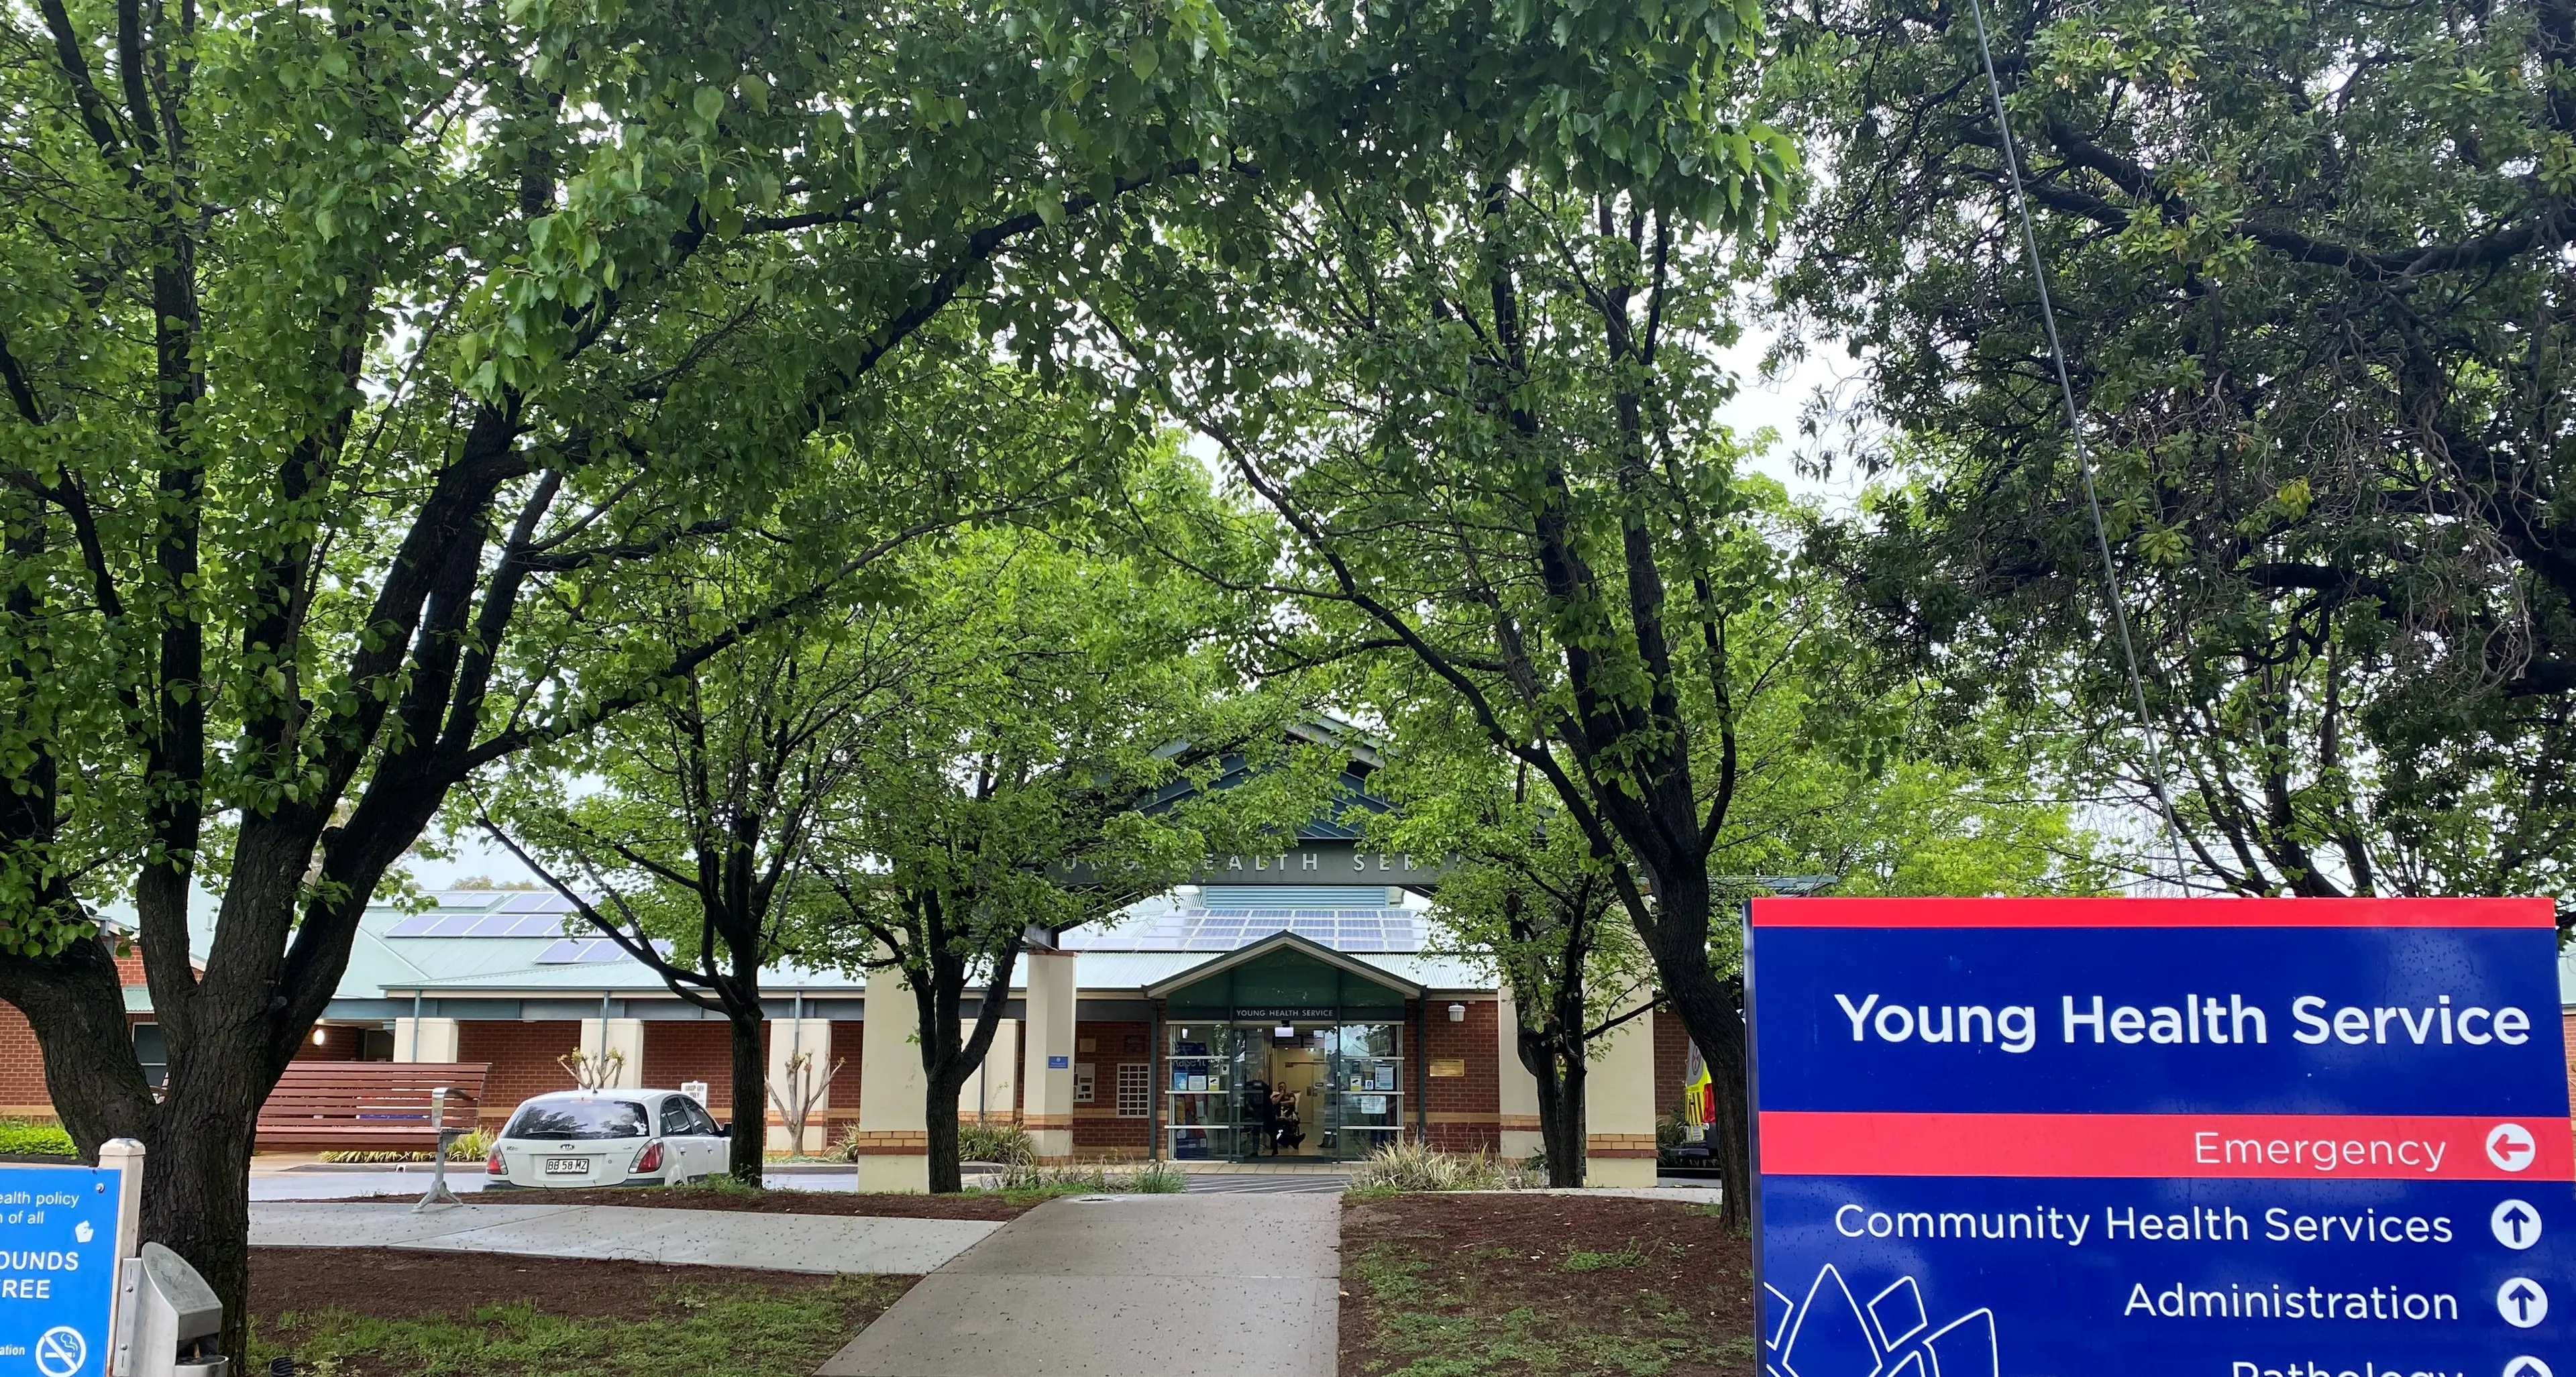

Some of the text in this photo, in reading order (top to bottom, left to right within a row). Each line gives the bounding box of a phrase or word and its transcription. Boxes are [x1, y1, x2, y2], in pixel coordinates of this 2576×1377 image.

[1203, 853, 1318, 871] EALTH
[1833, 994, 2530, 1053] Young Health Service
[2195, 1132, 2447, 1172] Emergency
[561, 1160, 572, 1170] 58
[36, 1191, 80, 1209] policy
[9, 1211, 23, 1224] of
[28, 1211, 44, 1224] all
[1835, 1203, 2453, 1246] Community Health Services
[0, 1279, 51, 1299] REE
[2124, 1282, 2458, 1320] Administration
